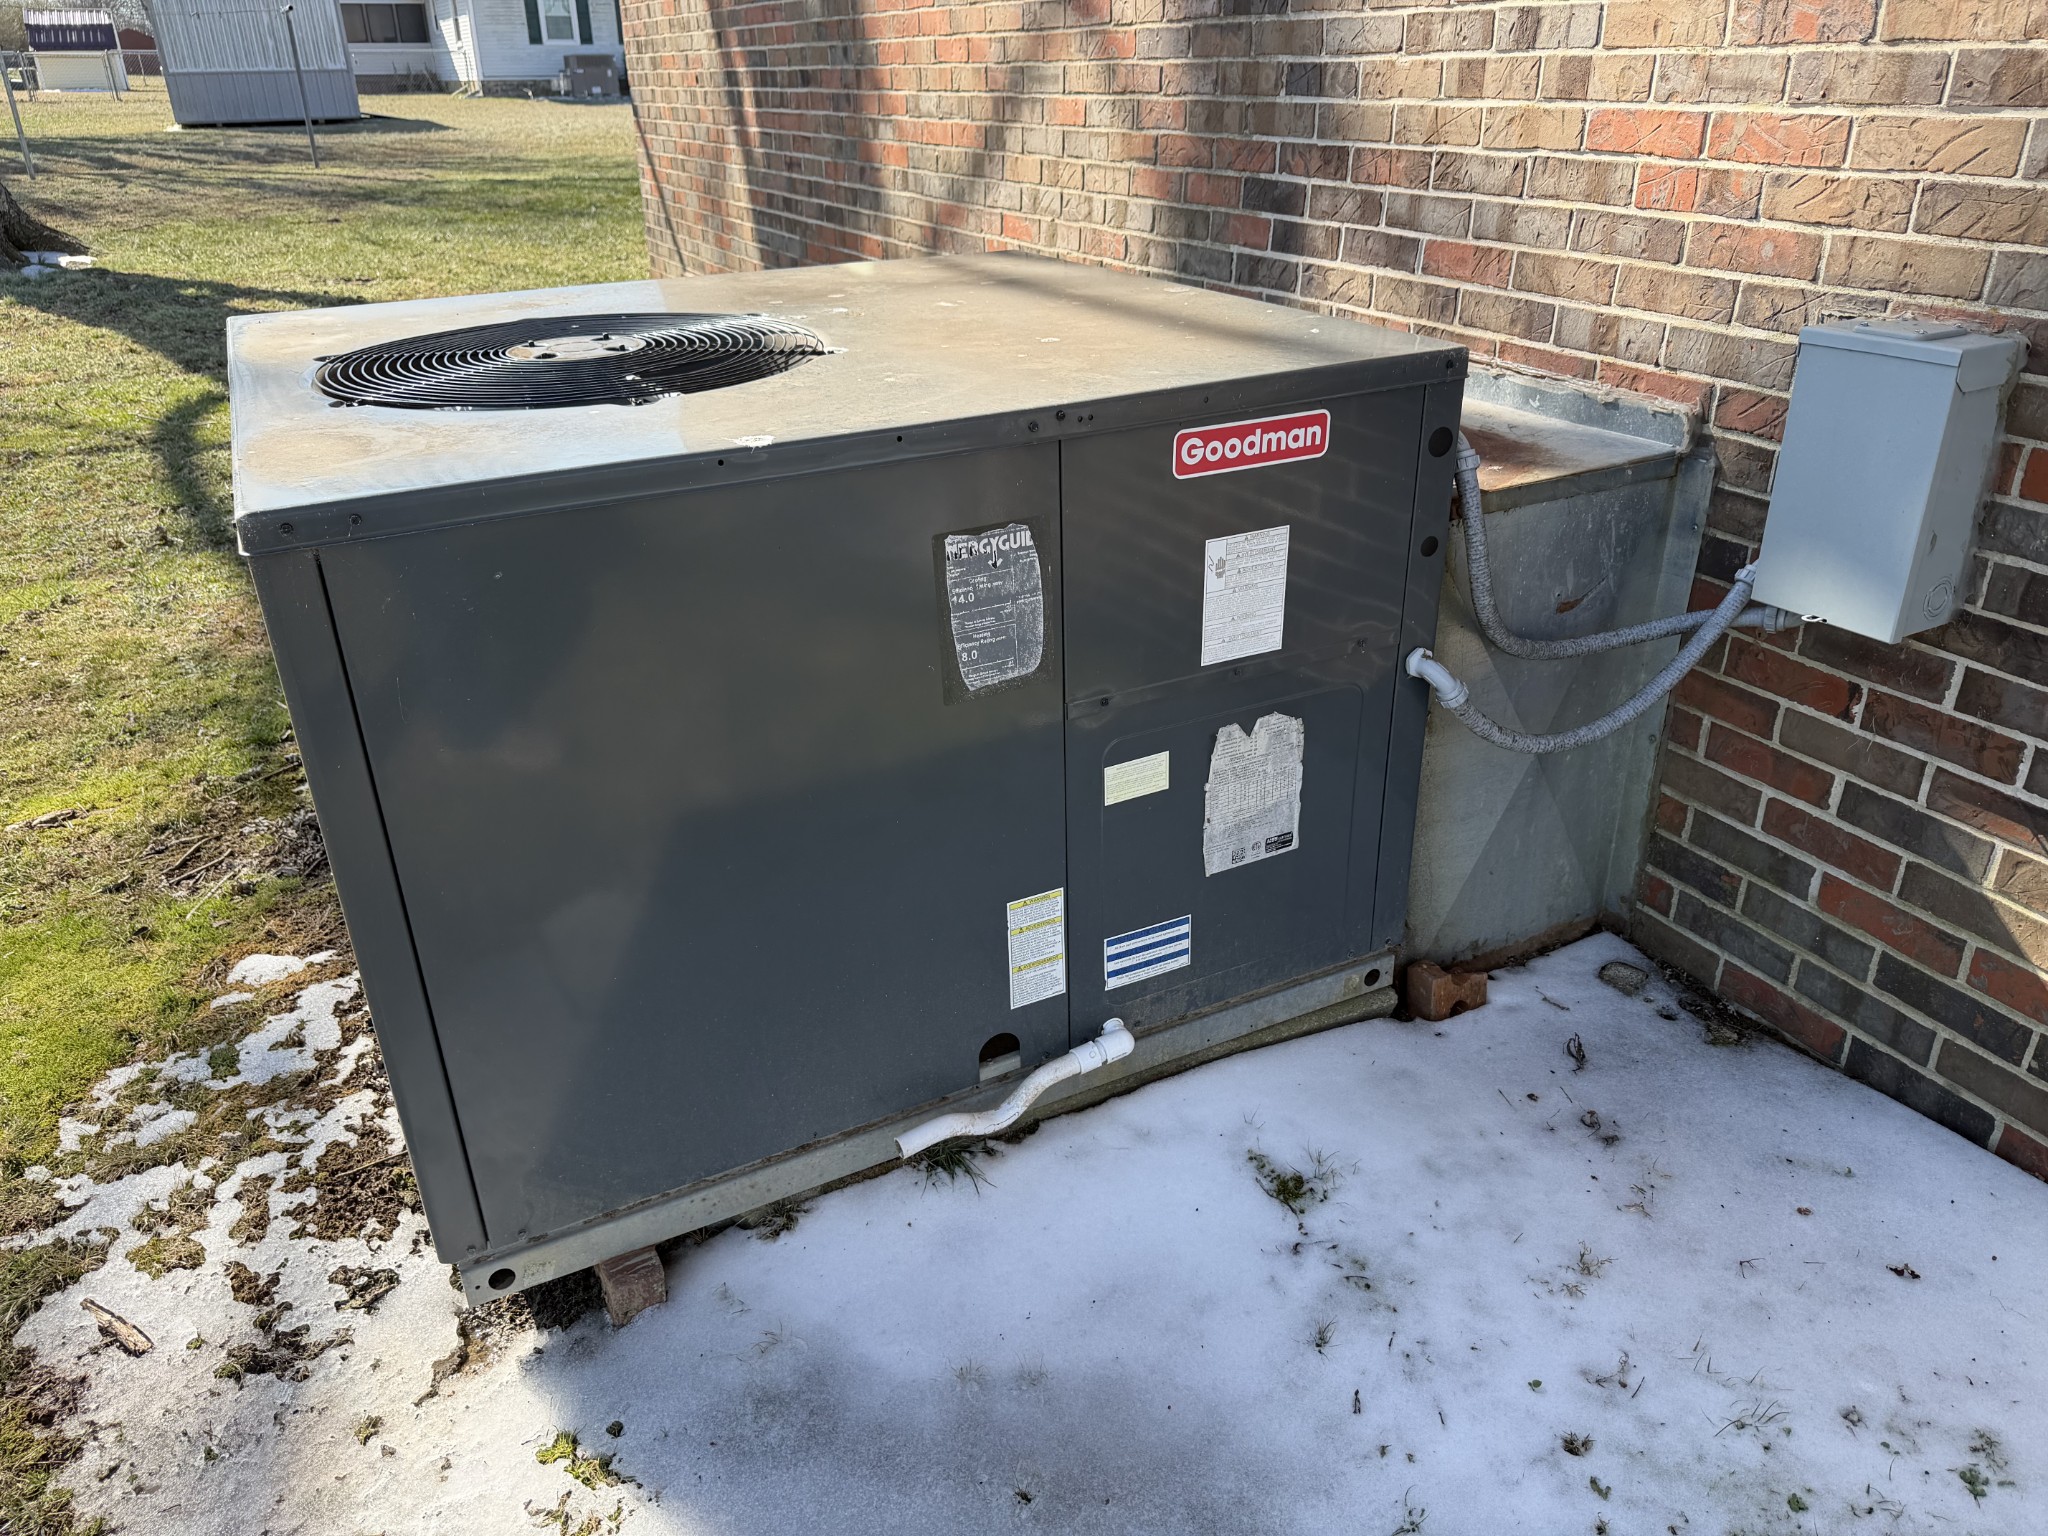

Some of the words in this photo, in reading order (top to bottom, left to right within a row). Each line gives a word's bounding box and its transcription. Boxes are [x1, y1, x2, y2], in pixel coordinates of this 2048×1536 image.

[1181, 424, 1322, 465] Goodman
[946, 529, 1034, 562] NERGYGUID
[951, 592, 975, 605] 14.0
[962, 650, 978, 661] 8.0
